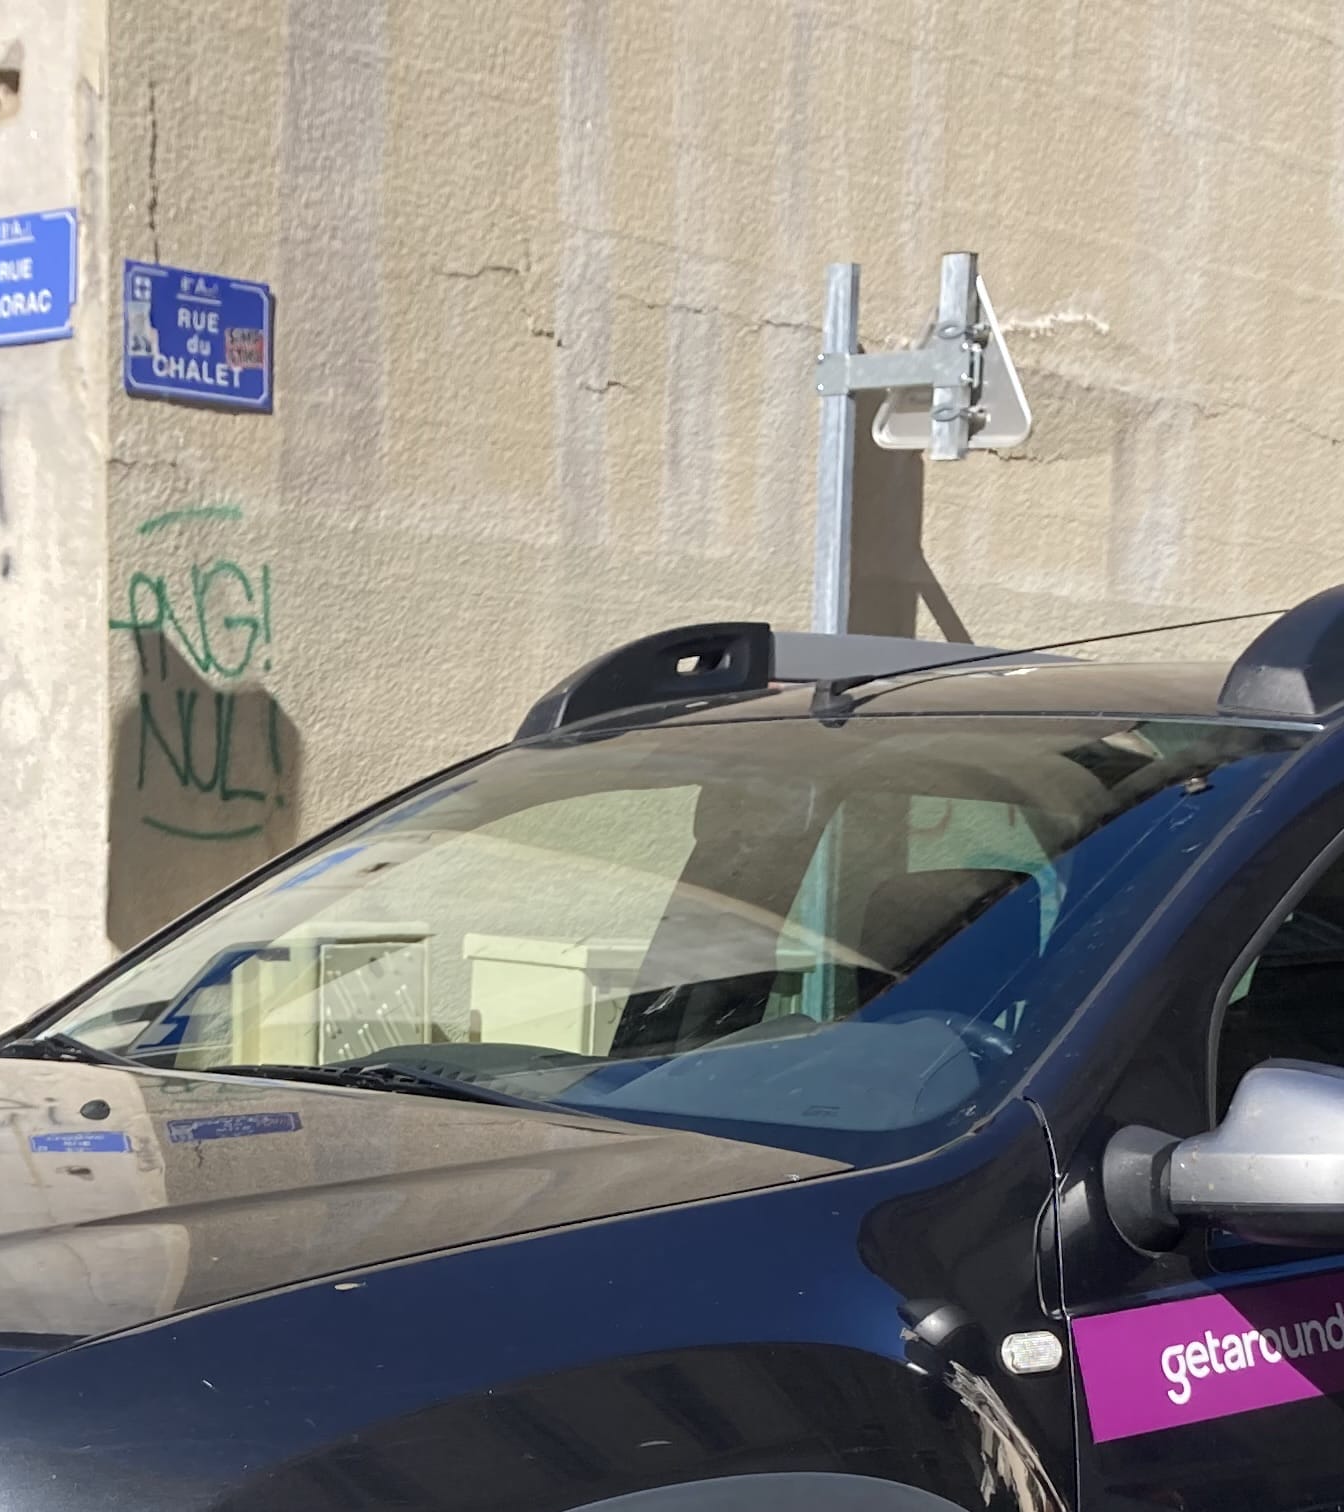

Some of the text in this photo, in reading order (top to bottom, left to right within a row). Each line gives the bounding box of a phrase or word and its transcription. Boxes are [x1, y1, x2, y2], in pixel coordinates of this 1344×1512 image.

[177, 308, 219, 334] RUE
[186, 334, 211, 356] du
[152, 353, 242, 388] CHALET
